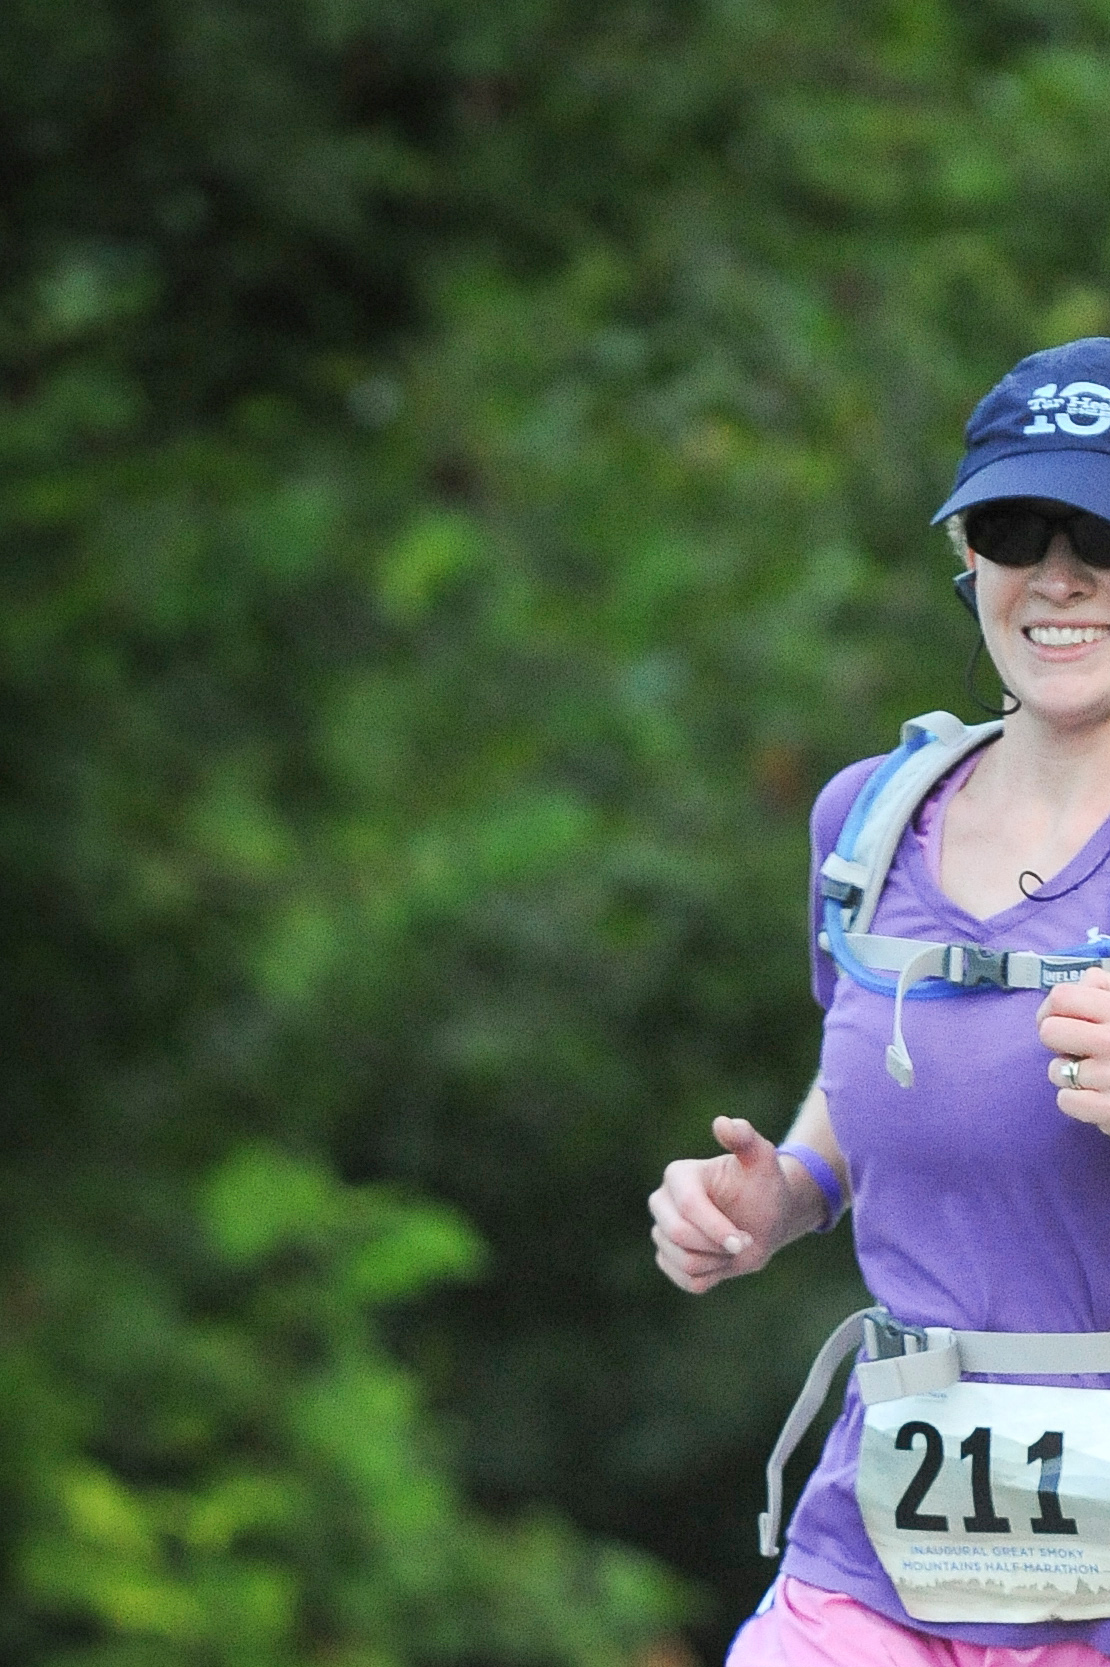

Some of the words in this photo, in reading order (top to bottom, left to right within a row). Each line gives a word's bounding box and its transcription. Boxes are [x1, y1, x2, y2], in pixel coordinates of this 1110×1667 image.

[894, 1420, 1078, 1535] 211
[992, 1546, 1034, 1557] GREAT
[1040, 1547, 1084, 1559] SMOKY
[903, 1560, 981, 1572] MOUNTAINS
